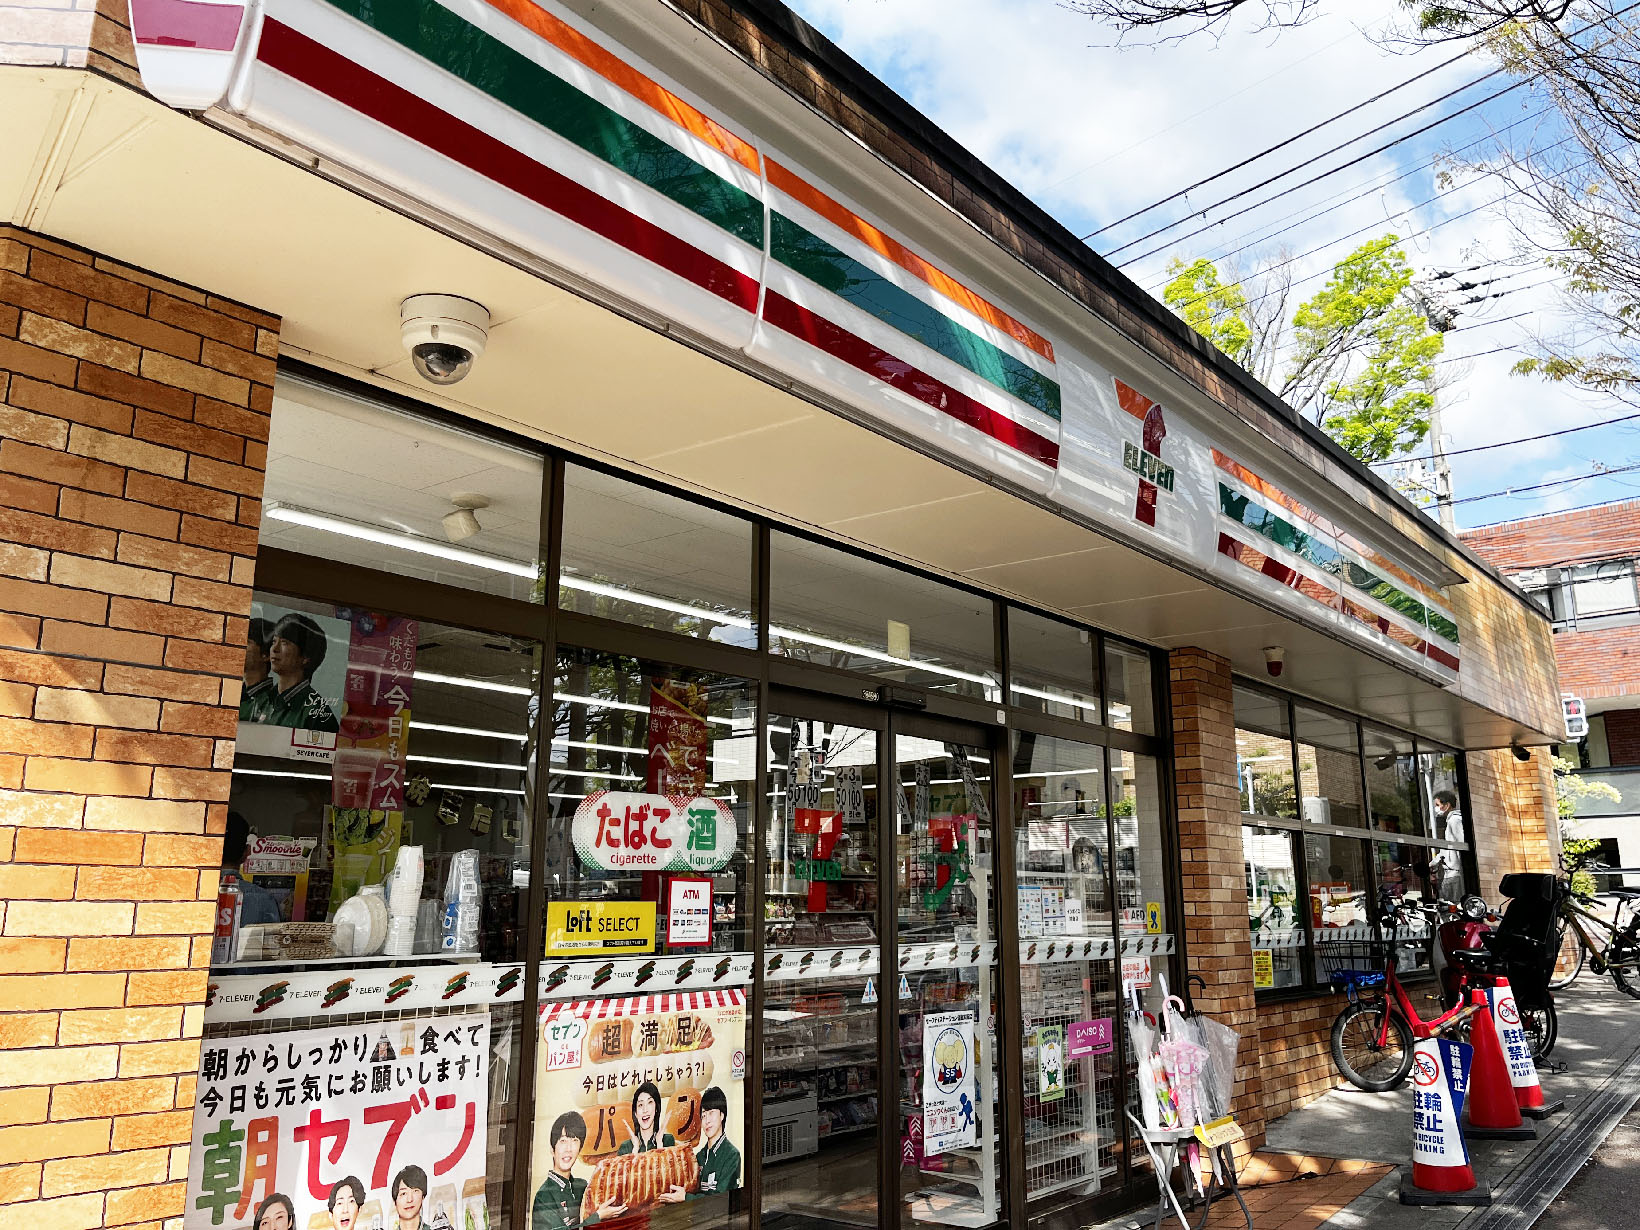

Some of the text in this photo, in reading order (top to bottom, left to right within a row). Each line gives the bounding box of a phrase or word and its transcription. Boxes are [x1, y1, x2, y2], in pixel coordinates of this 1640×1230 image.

[304, 691, 339, 707] Seven
[594, 802, 672, 850] たばこ
[686, 807, 717, 851] 酒
[610, 853, 657, 867] cigarette
[689, 854, 717, 869] liquor
[682, 889, 700, 900] ATM
[598, 917, 640, 933] SELECT
[551, 1021, 581, 1041] セブン
[601, 1016, 694, 1057] 超満足
[1076, 1026, 1097, 1039] DAISO
[201, 1023, 484, 1082] 朝からしっかり 食べて
[1449, 1045, 1465, 1092] 駐輪禁止
[199, 1054, 481, 1117] 今日も元気にお願いします!
[593, 1095, 695, 1151] パン
[1418, 1133, 1444, 1145] BICYCLE
